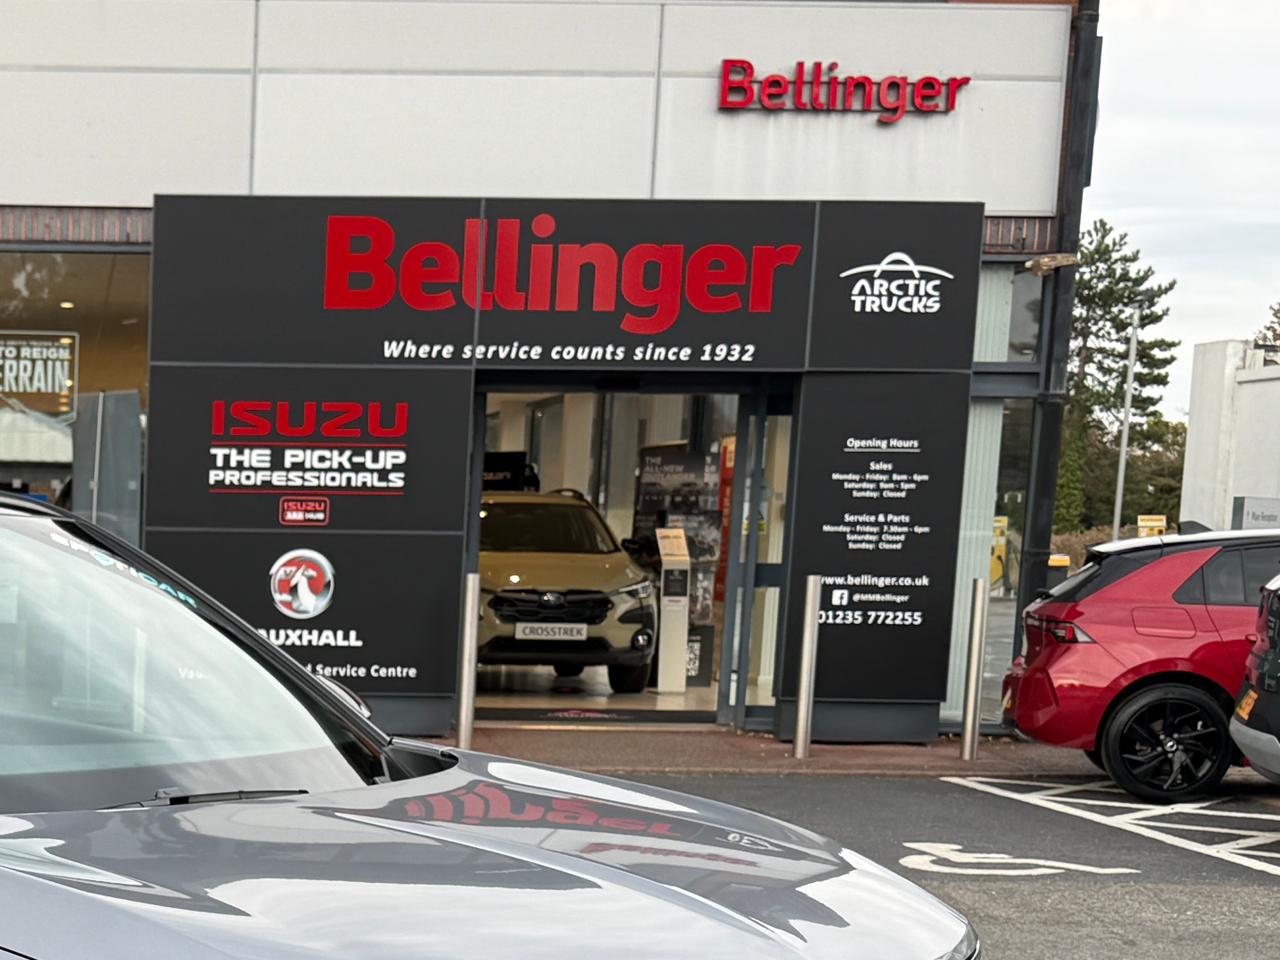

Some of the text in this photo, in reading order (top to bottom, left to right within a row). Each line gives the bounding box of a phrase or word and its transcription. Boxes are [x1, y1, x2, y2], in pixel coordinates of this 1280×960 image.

[719, 59, 971, 123] Bellinger
[324, 214, 802, 335] Bellinger
[851, 279, 941, 296] ARCTIC
[851, 296, 941, 313] TRUCKS
[20, 347, 70, 360] REIGN
[383, 341, 756, 362] Where service counts since 1932
[211, 400, 408, 437] ISUZU
[846, 438, 919, 449] Opening Hours
[210, 448, 407, 470] THE PICK-UP
[869, 461, 893, 471] Sales
[209, 469, 405, 488] PROFESSIONALS
[284, 501, 325, 511] ISUZU
[844, 513, 876, 523] Service
[887, 513, 910, 523] Parts
[866, 611, 923, 625] 772255
[257, 628, 363, 647] AUXHALL
[521, 626, 584, 637] CROSSTREK
[315, 663, 367, 678] Service
[370, 664, 418, 679] Centre
